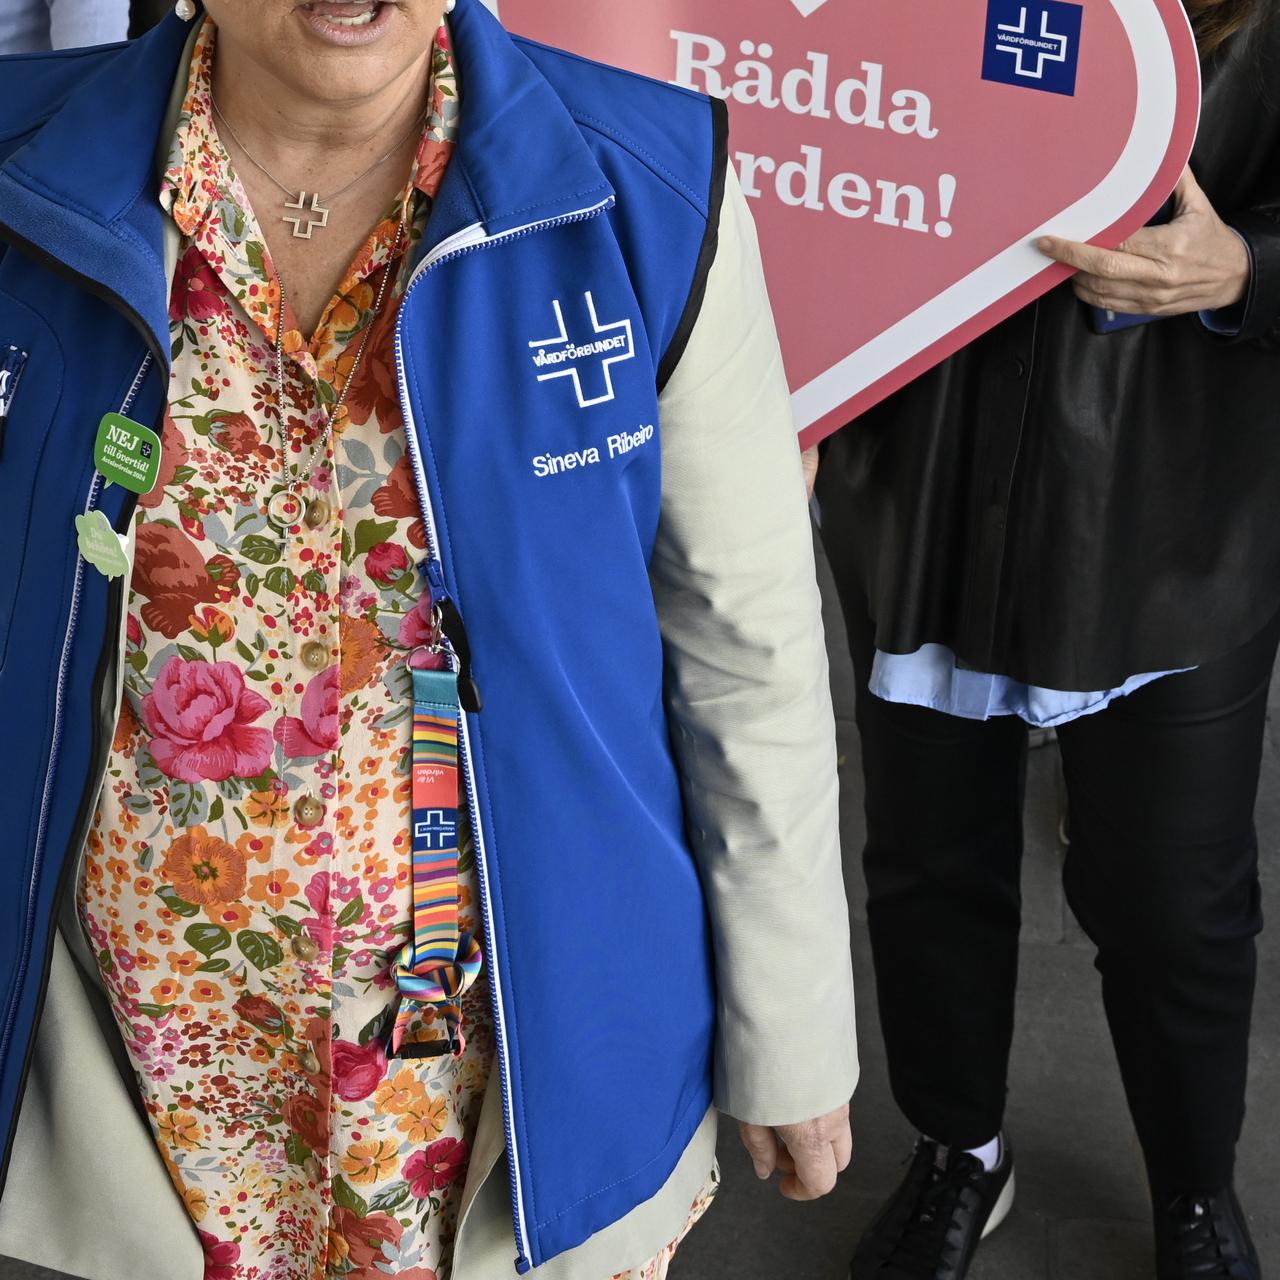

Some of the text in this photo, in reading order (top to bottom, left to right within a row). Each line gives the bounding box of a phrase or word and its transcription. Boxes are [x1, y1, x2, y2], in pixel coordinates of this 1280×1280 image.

[997, 33, 1058, 51] VÅRDFÖRBUNDET
[670, 29, 939, 140] Rädda
[532, 335, 626, 367] VÅRDFÖRBUNDET
[105, 424, 140, 451] NEJ
[532, 423, 654, 478] Sineva Ribeiro
[104, 444, 150, 473] till övertid!
